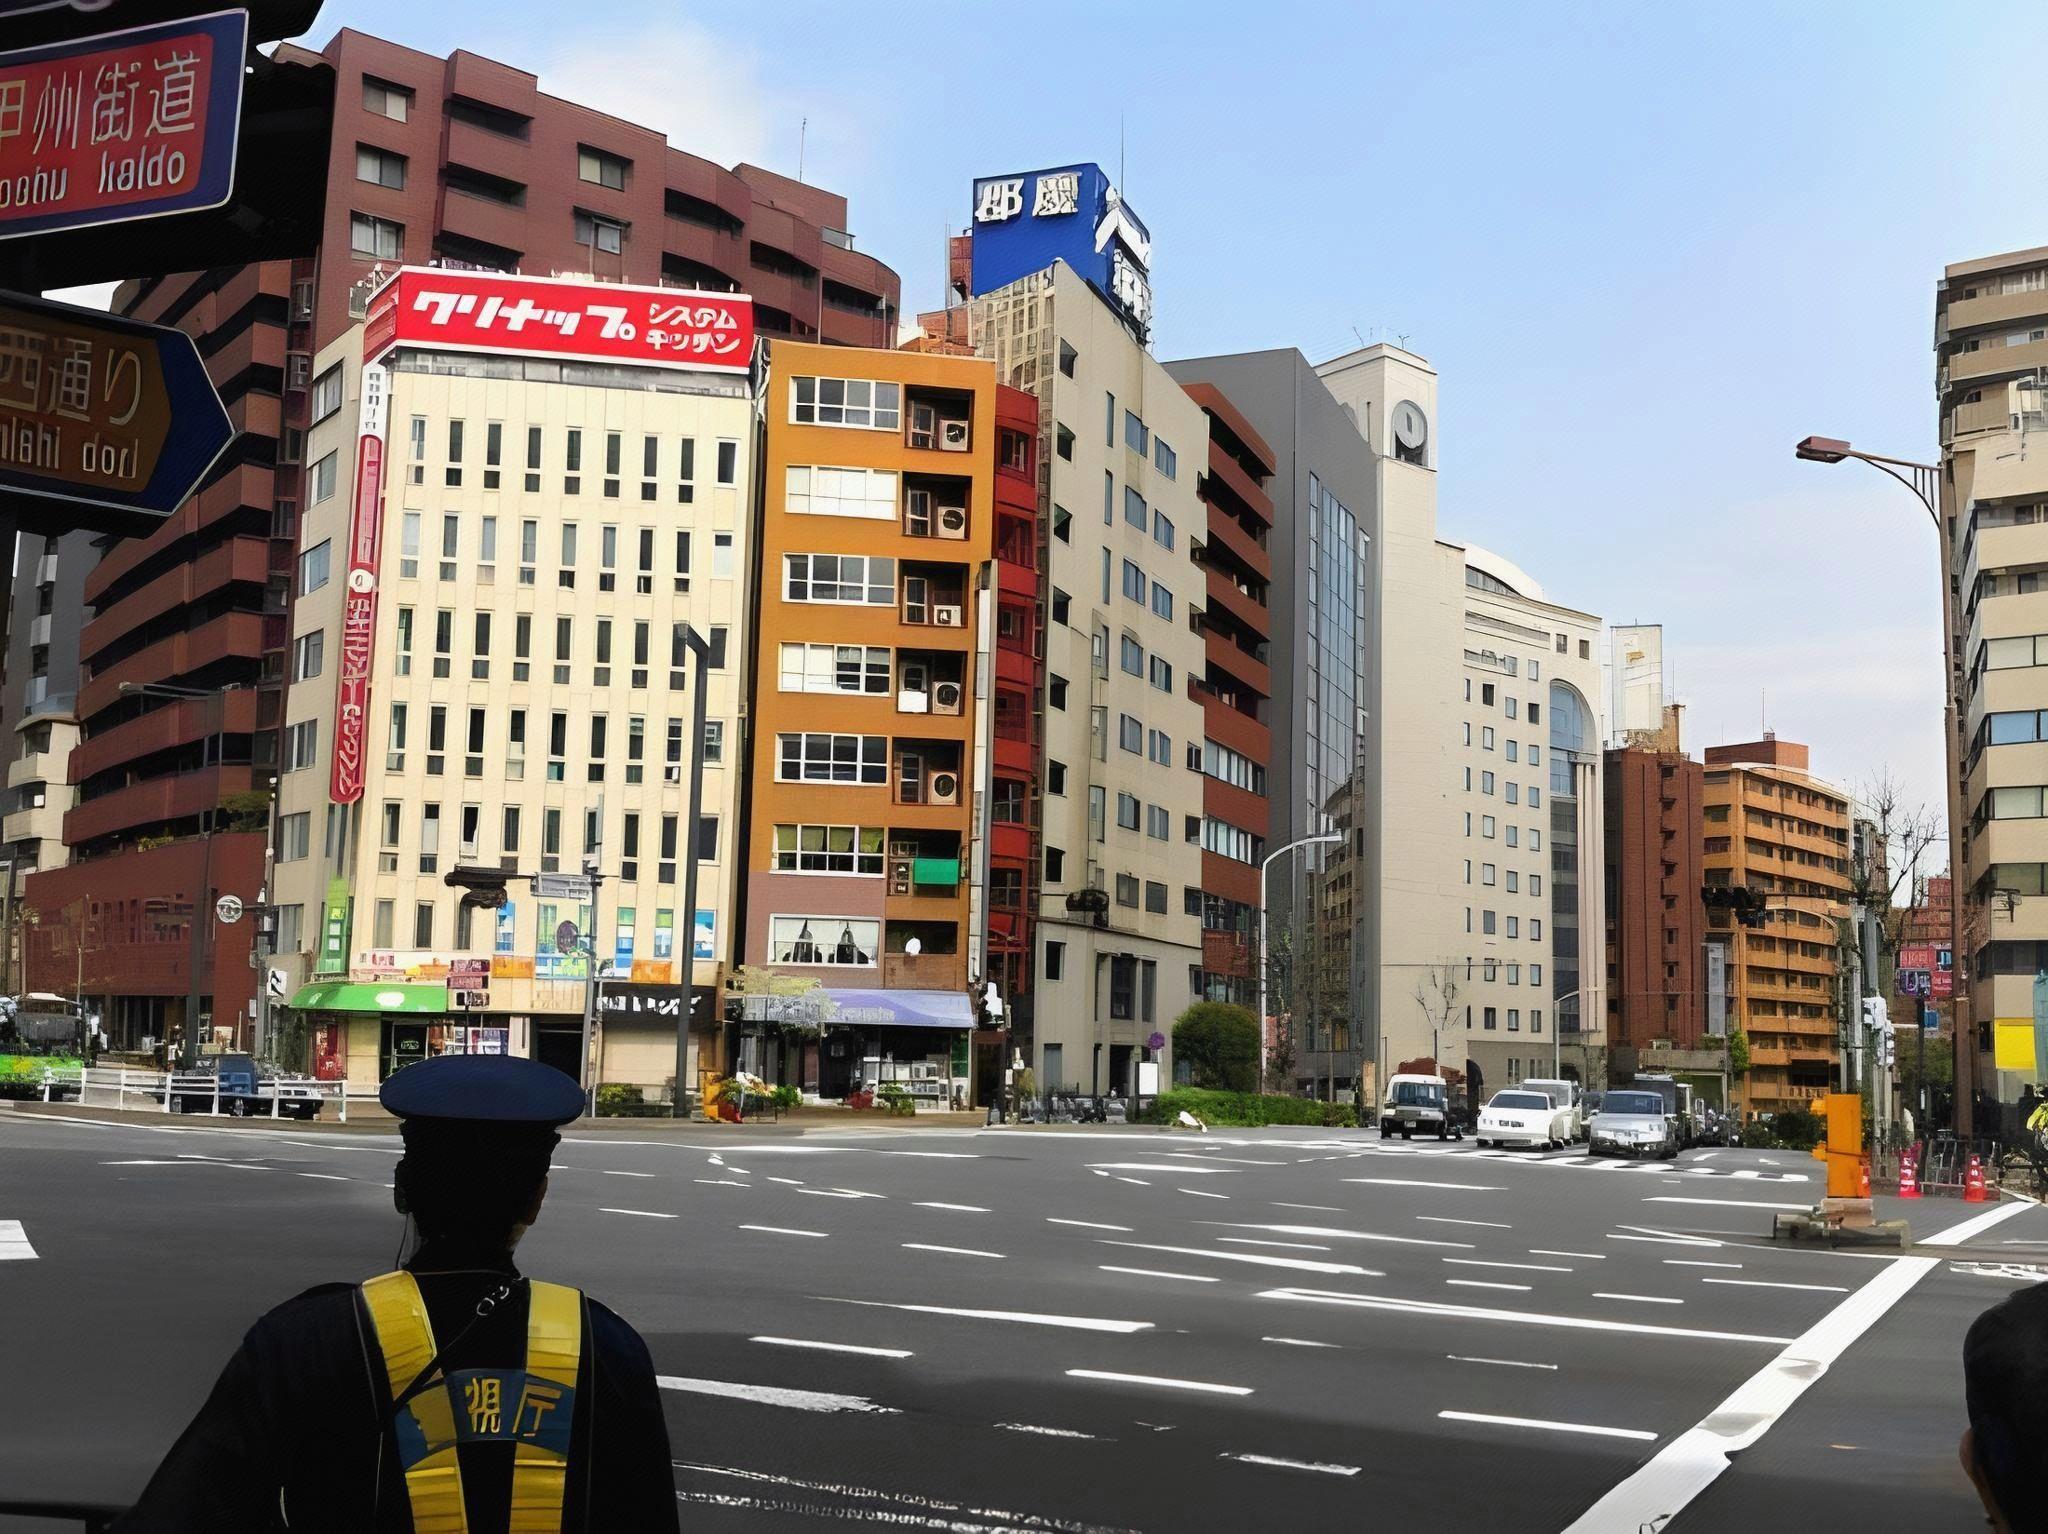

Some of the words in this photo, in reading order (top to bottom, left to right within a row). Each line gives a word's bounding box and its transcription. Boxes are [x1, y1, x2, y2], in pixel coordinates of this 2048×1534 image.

[413, 290, 637, 341] クリナップ
[649, 302, 738, 329] システム
[645, 329, 741, 354] キッチン
